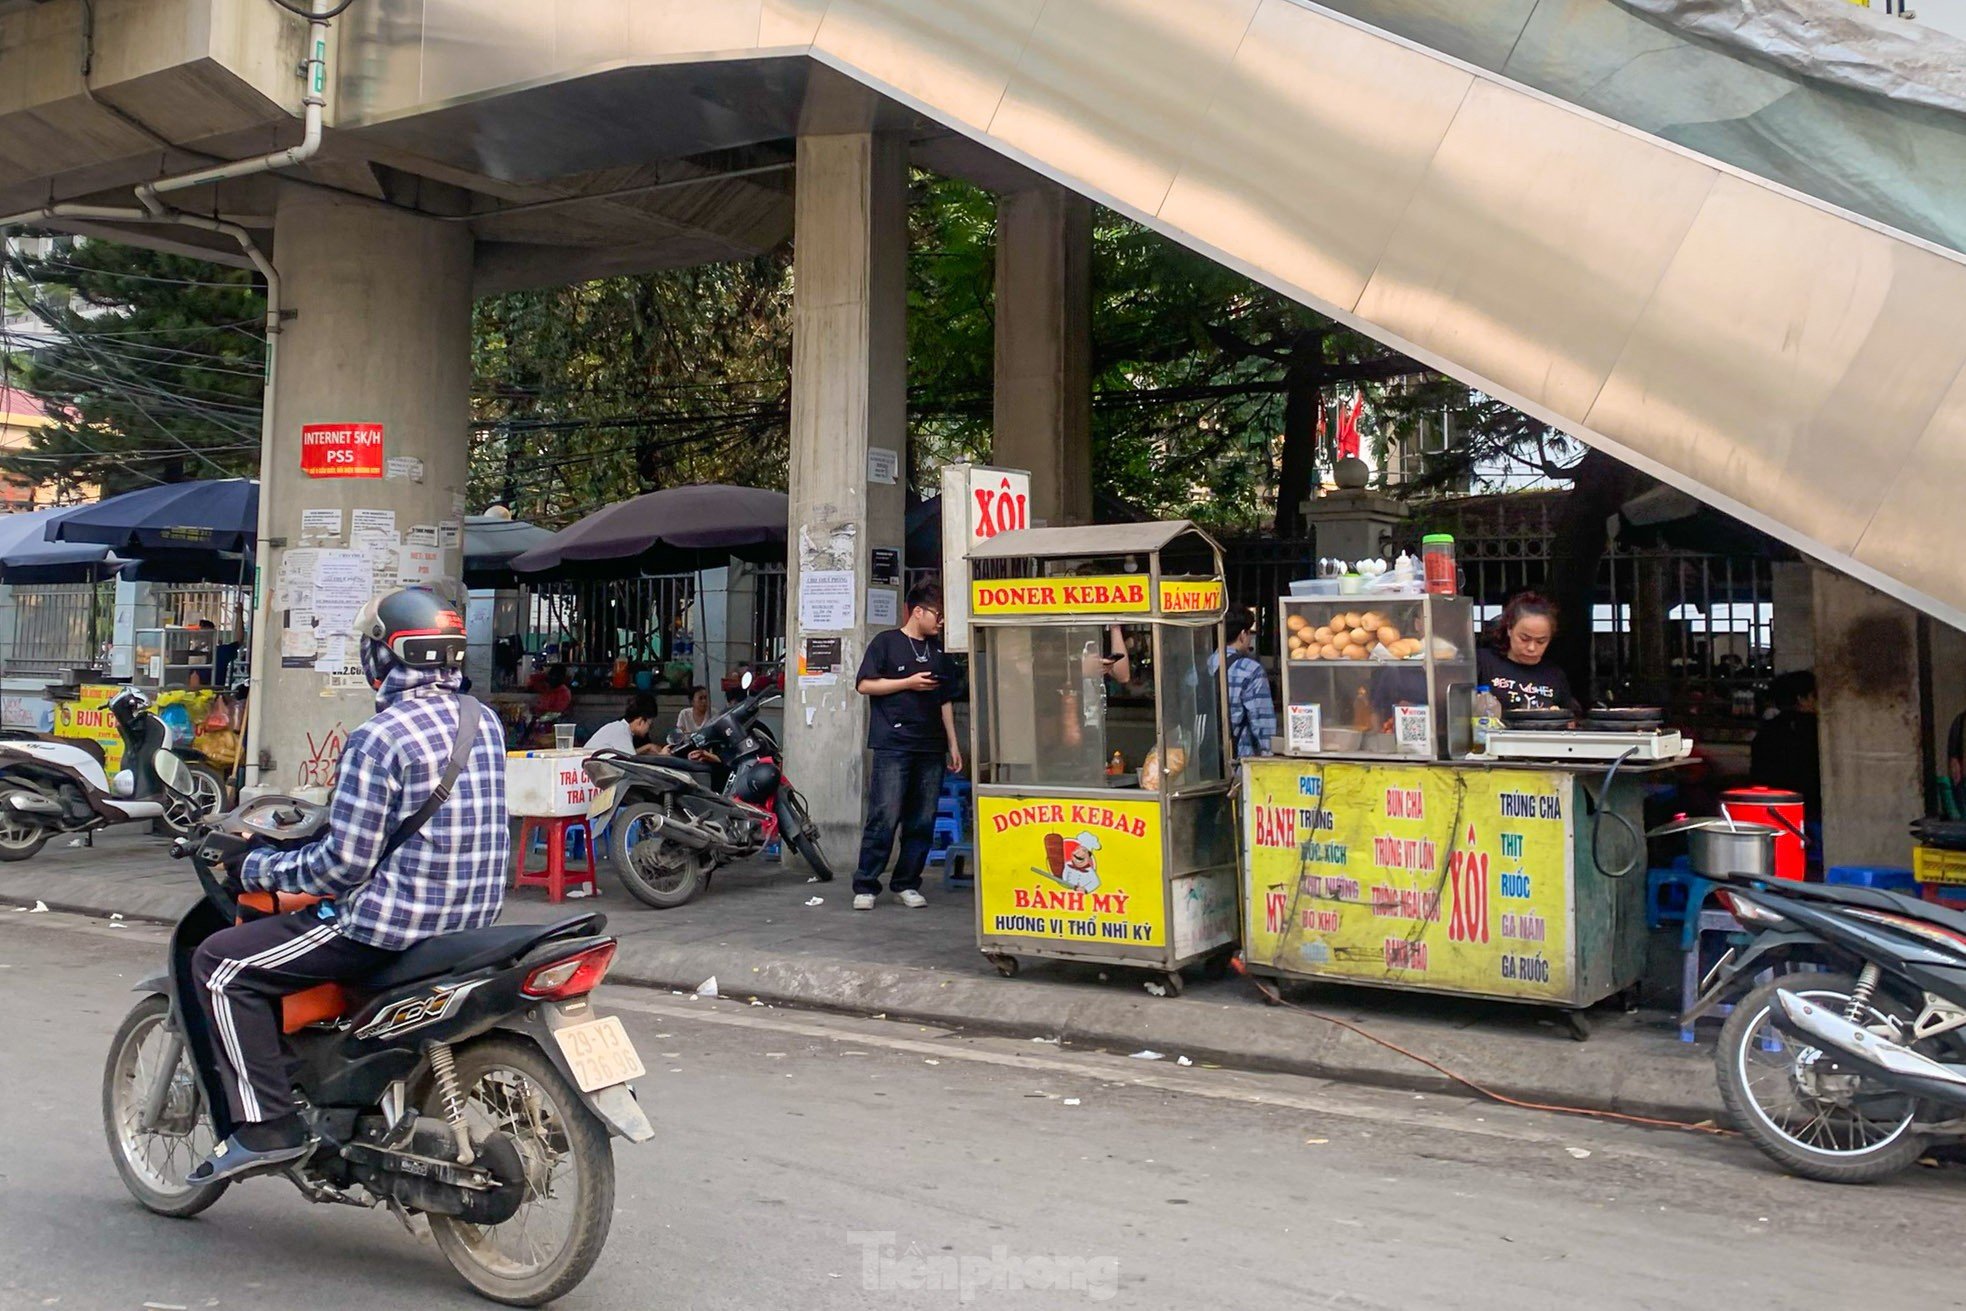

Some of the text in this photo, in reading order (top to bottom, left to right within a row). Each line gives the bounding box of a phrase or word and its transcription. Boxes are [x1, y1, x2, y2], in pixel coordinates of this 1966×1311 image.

[304, 431, 381, 446] INTERNET 5K/H
[327, 450, 354, 463] PS5
[979, 585, 1144, 606] DONER KEBAB
[1163, 586, 1200, 611] BÁNH
[1300, 776, 1322, 796] PATE
[1539, 789, 1562, 819] CHẢ
[992, 805, 1147, 838] DONER KEBAB
[1255, 794, 1296, 848] BÁNH
[1501, 833, 1524, 862] THỊT
[1448, 822, 1489, 943] XÔI
[1501, 867, 1530, 898] RUỐC
[1014, 885, 1130, 914] BÁNH MỲ
[995, 914, 1045, 933] HƯƠNG
[1050, 919, 1063, 938] VỊ
[1068, 915, 1097, 936] THỔ
[1501, 951, 1549, 983] GÀ RUỐC
